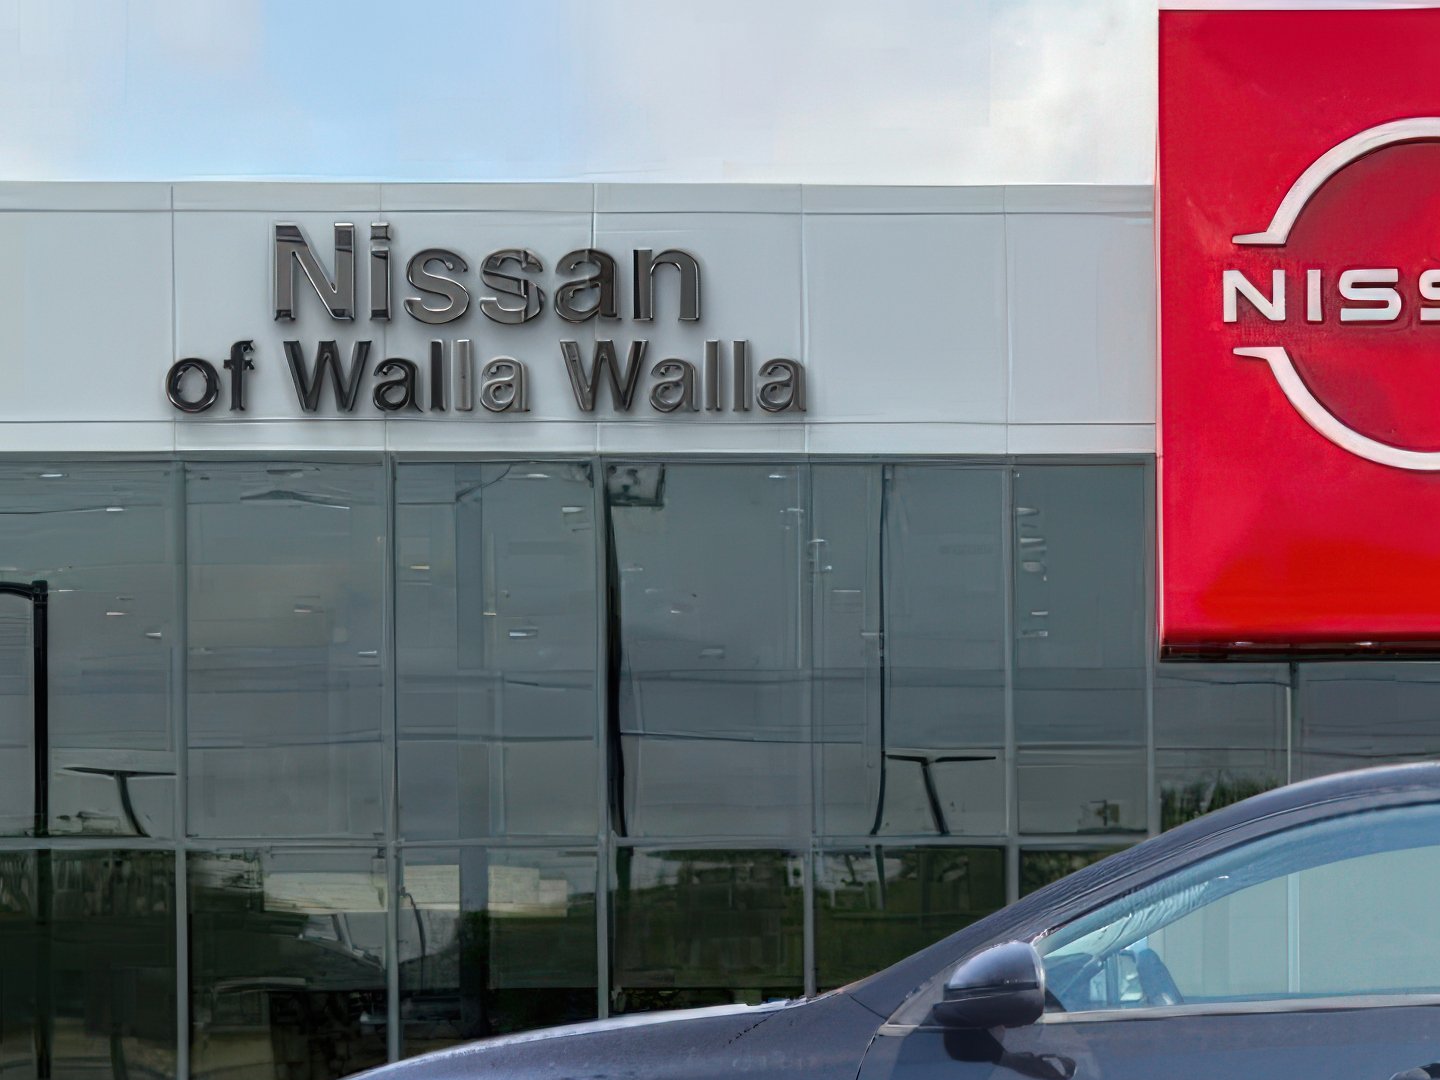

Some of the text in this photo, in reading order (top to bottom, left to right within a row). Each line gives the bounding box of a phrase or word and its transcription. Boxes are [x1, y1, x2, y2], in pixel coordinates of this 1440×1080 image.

[272, 222, 703, 323] Nissan
[166, 339, 807, 413] of Walla Walla
